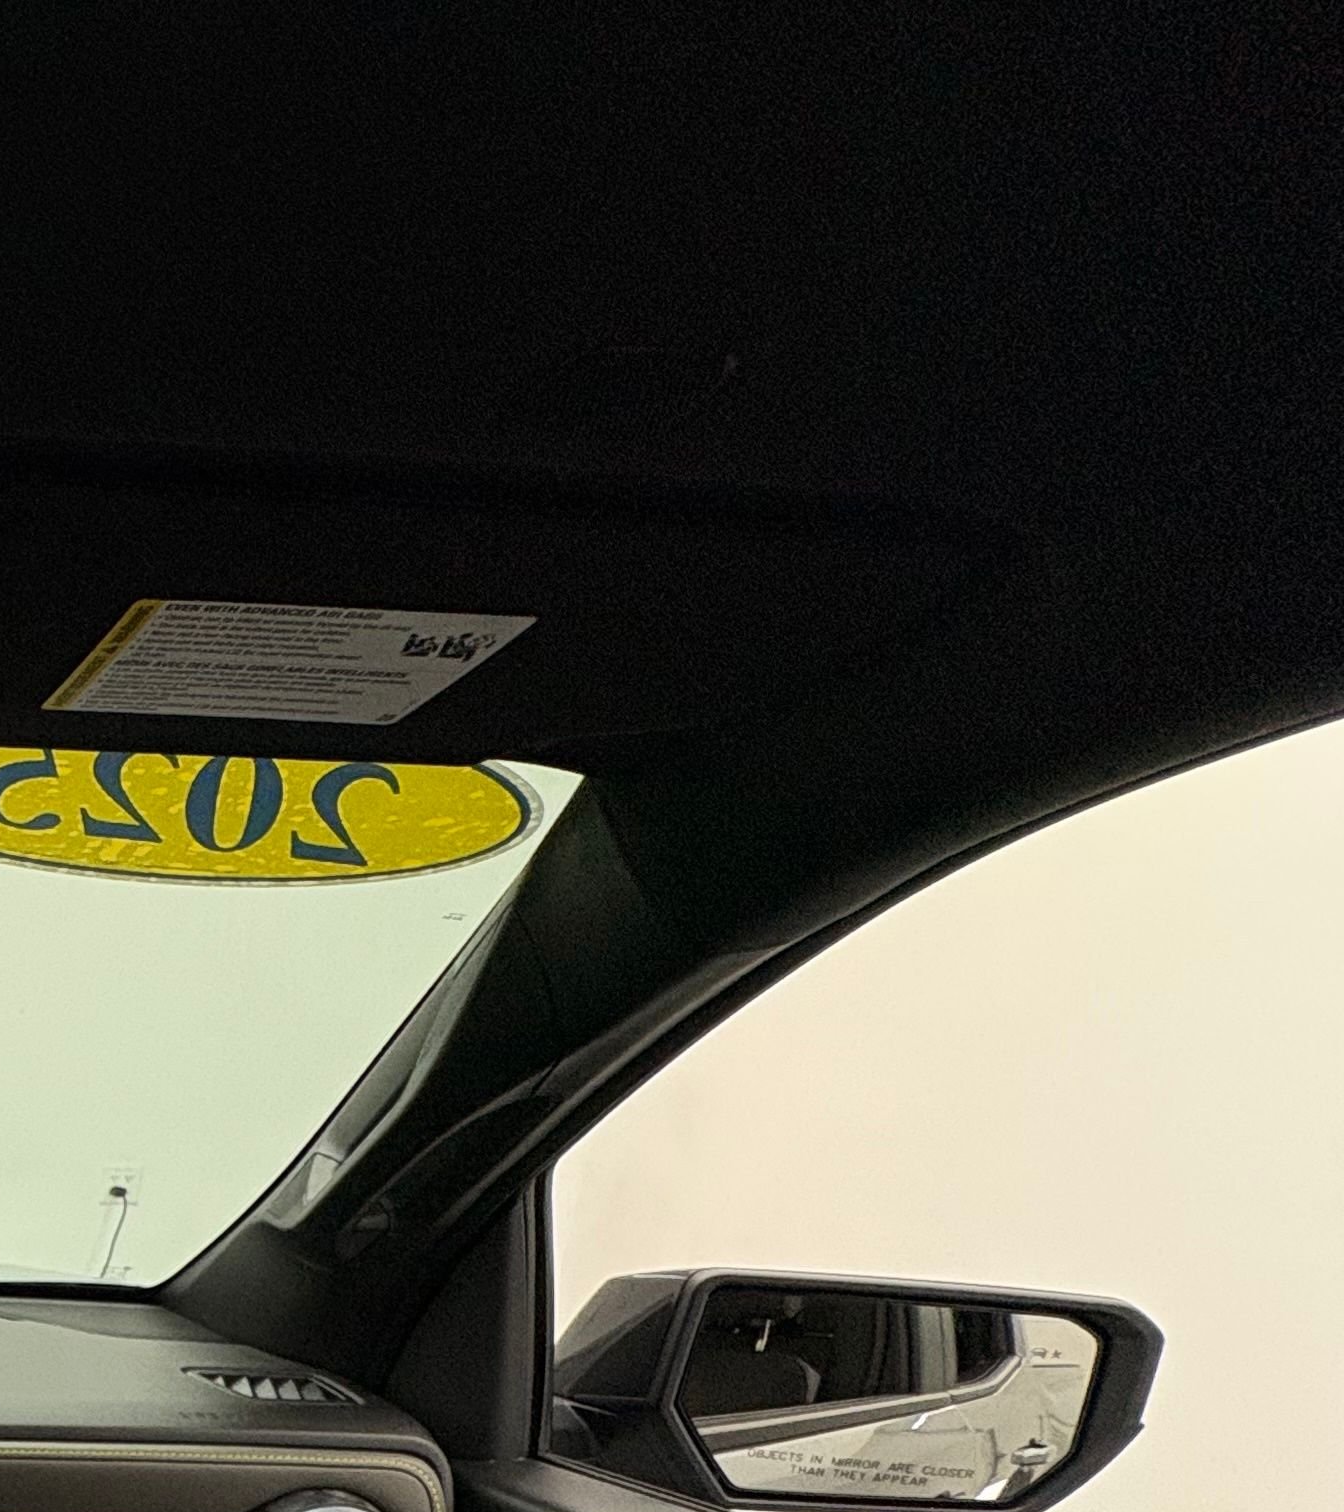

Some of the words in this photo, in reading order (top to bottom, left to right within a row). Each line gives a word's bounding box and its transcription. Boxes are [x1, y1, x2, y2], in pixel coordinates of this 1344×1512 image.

[747, 1450, 803, 1463] OBJECTS
[810, 1455, 823, 1464] IN
[831, 1457, 880, 1470] MIRROR
[888, 1462, 914, 1474] ARE
[922, 1465, 975, 1479] CLOSER
[791, 1464, 825, 1477] THAN
[833, 1469, 865, 1481] THEY
[872, 1473, 928, 1487] APPEAR
